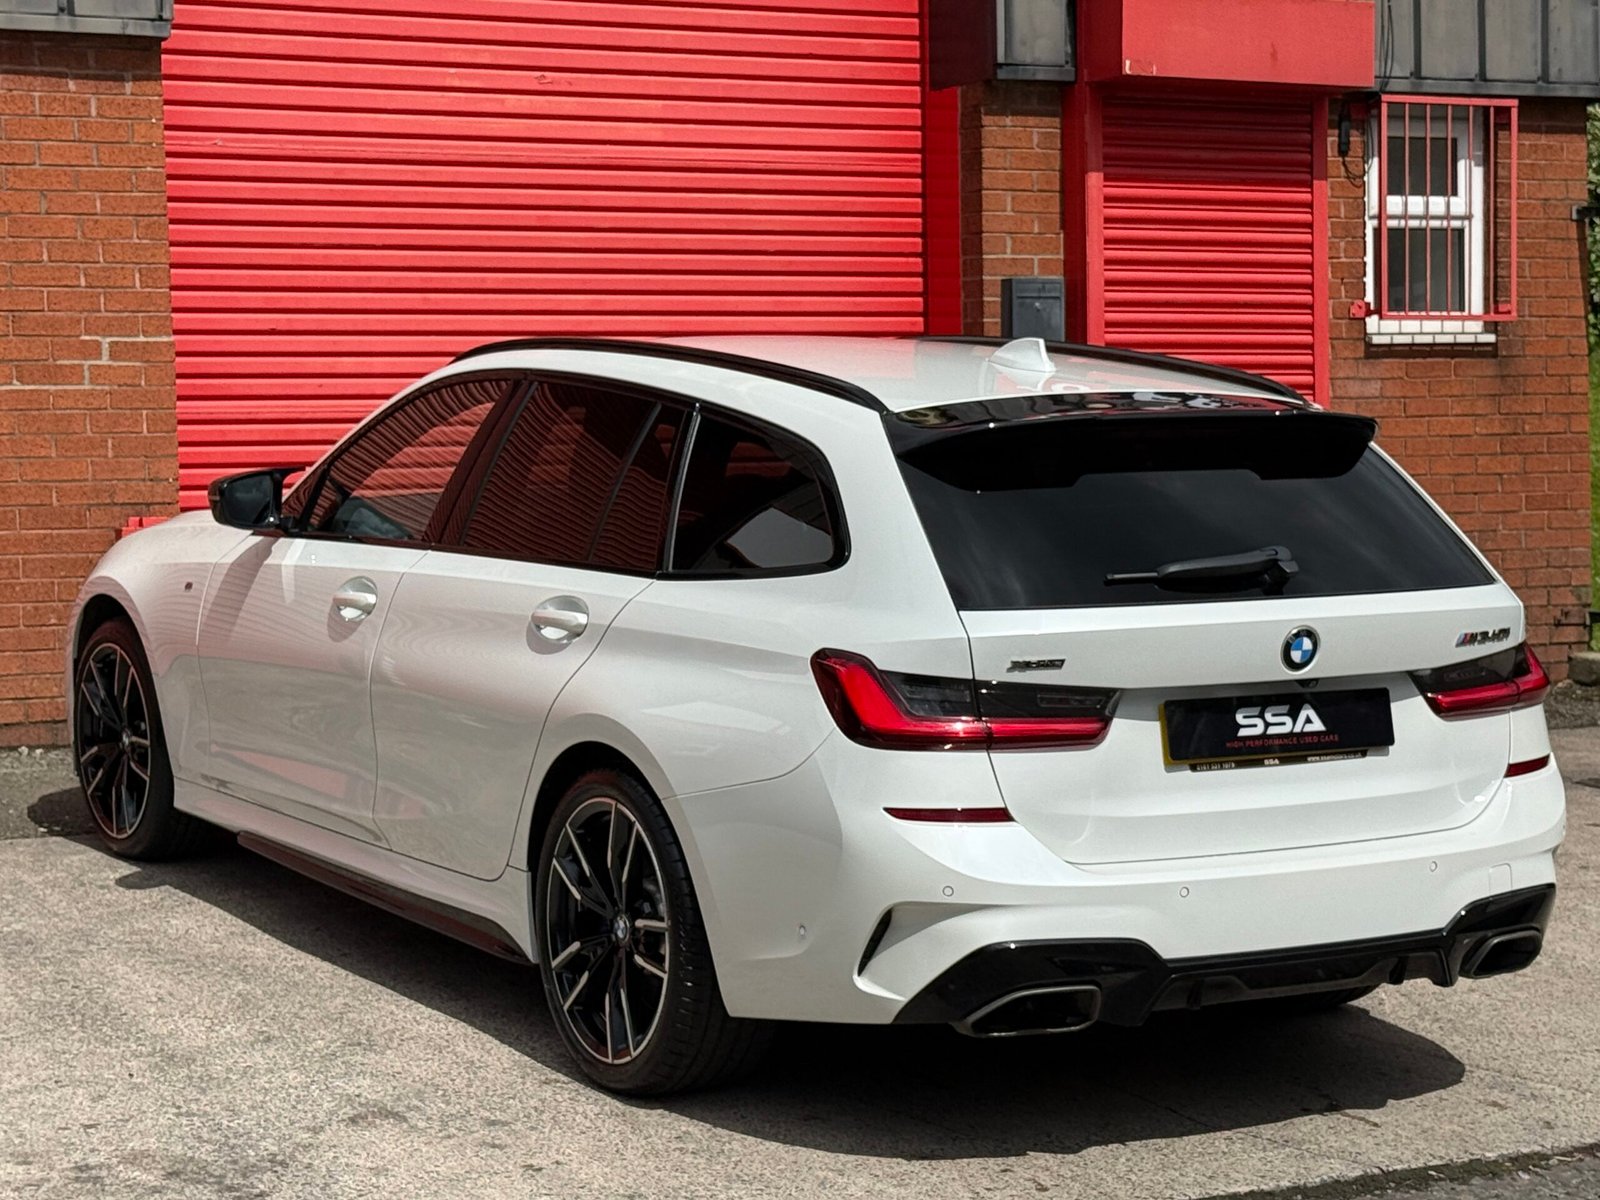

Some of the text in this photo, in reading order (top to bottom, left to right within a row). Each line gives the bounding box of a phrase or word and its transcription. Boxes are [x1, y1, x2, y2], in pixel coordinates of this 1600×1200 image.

[1235, 703, 1327, 737] SSA
[1225, 734, 1340, 749] HIGH PERFORMANCE USED CARS
